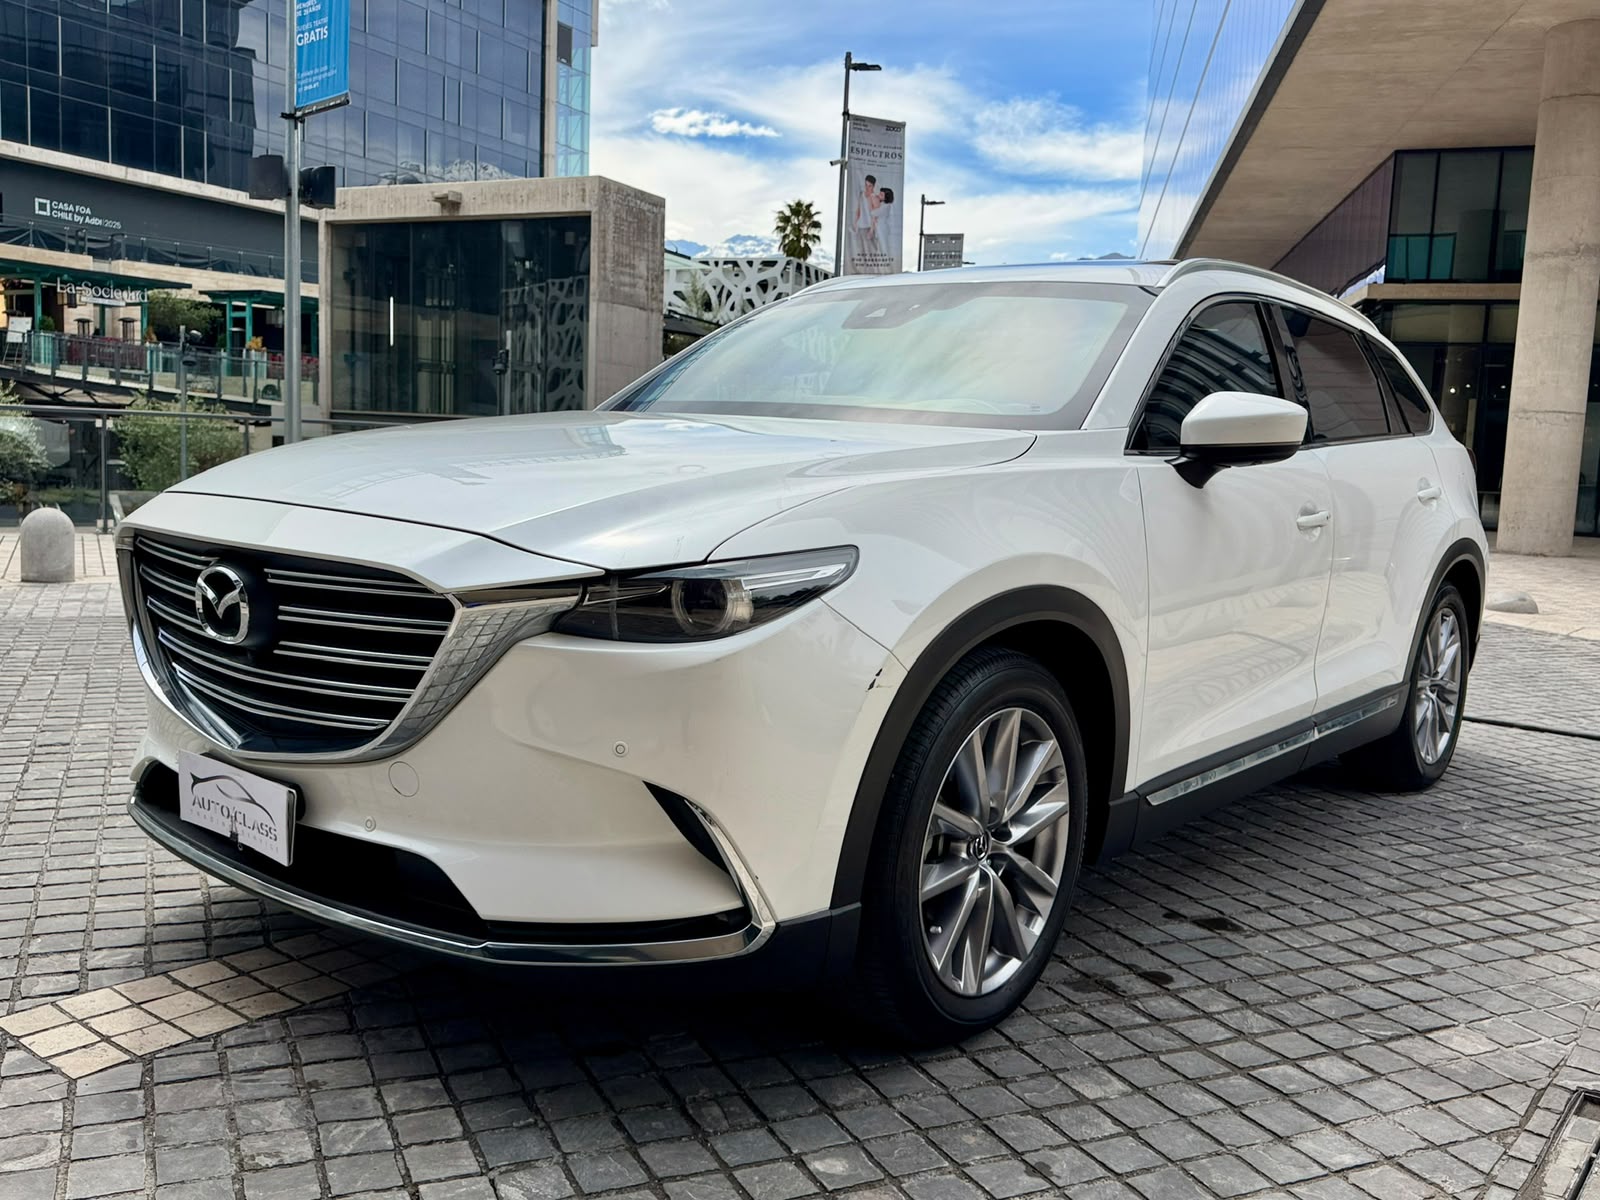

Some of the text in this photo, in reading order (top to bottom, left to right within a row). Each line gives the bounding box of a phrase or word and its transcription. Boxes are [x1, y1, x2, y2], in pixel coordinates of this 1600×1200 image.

[296, 25, 329, 47] GRATIS
[850, 146, 903, 160] ESPECTROS
[52, 201, 92, 215] CASA FOA
[52, 210, 73, 221] CHILE
[73, 213, 84, 224] by
[56, 277, 76, 294] La
